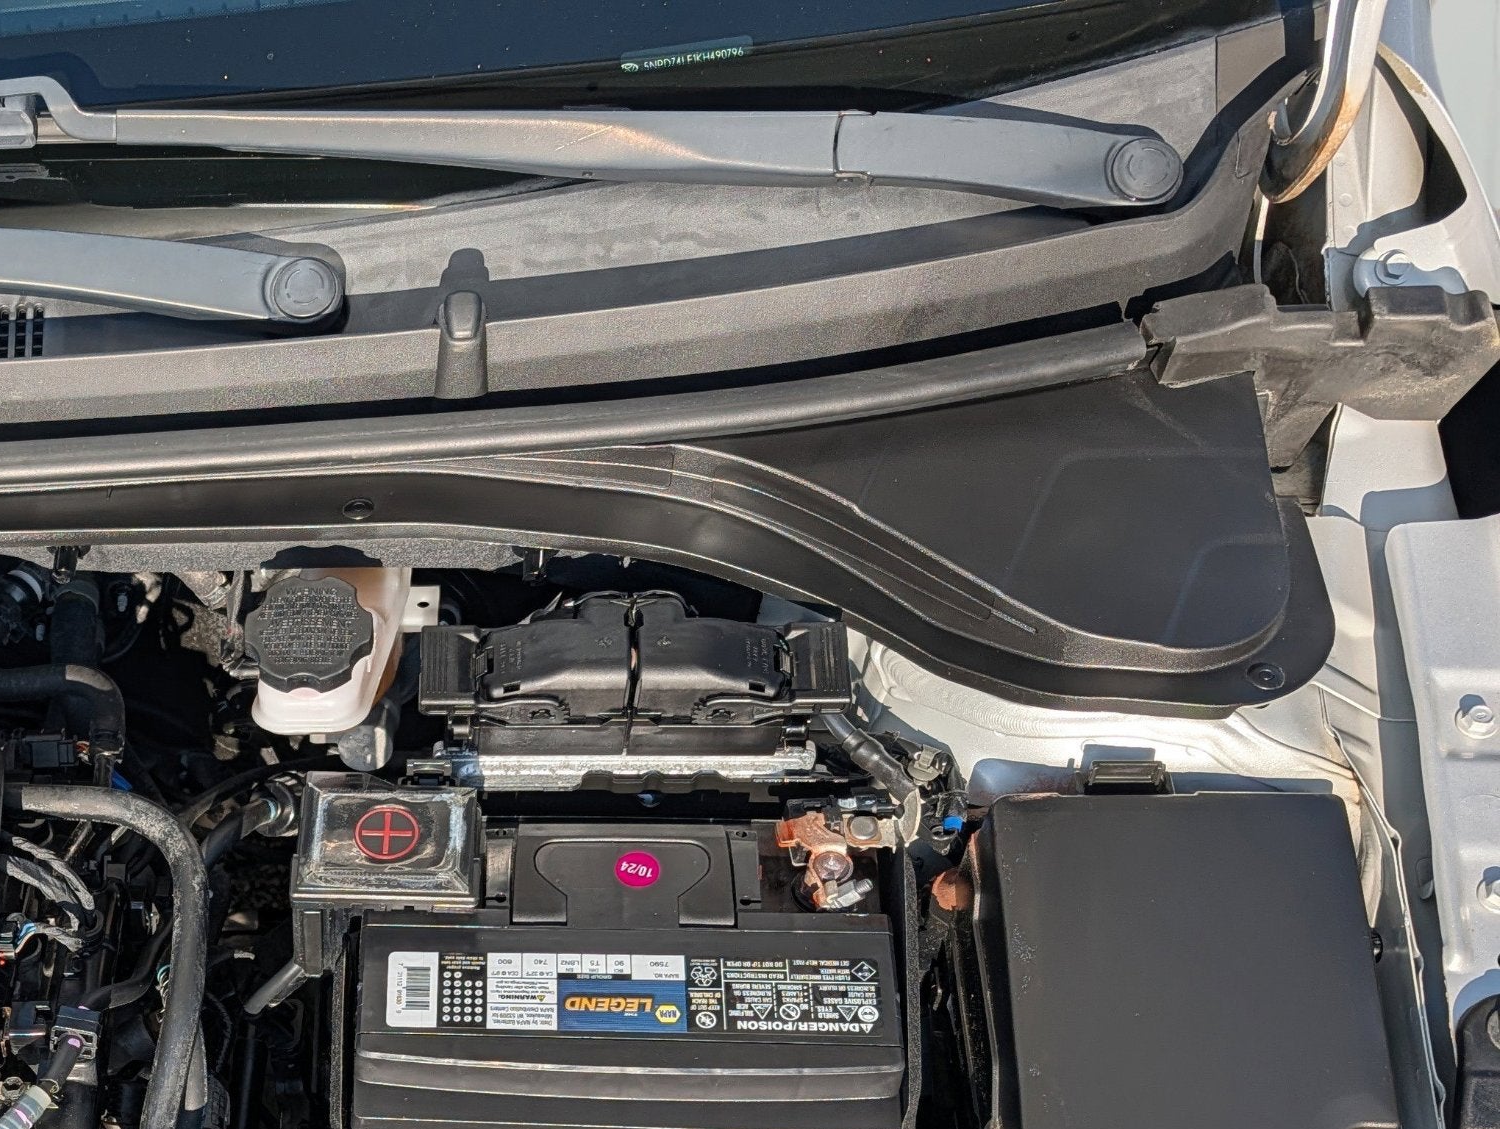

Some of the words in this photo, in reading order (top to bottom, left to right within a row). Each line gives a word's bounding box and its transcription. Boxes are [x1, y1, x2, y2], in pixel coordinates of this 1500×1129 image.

[621, 861, 652, 877] 10/24
[564, 997, 653, 1012] LEGEND
[659, 1010, 677, 1018] NAPA
[737, 1021, 860, 1032] DANGER/POISON
